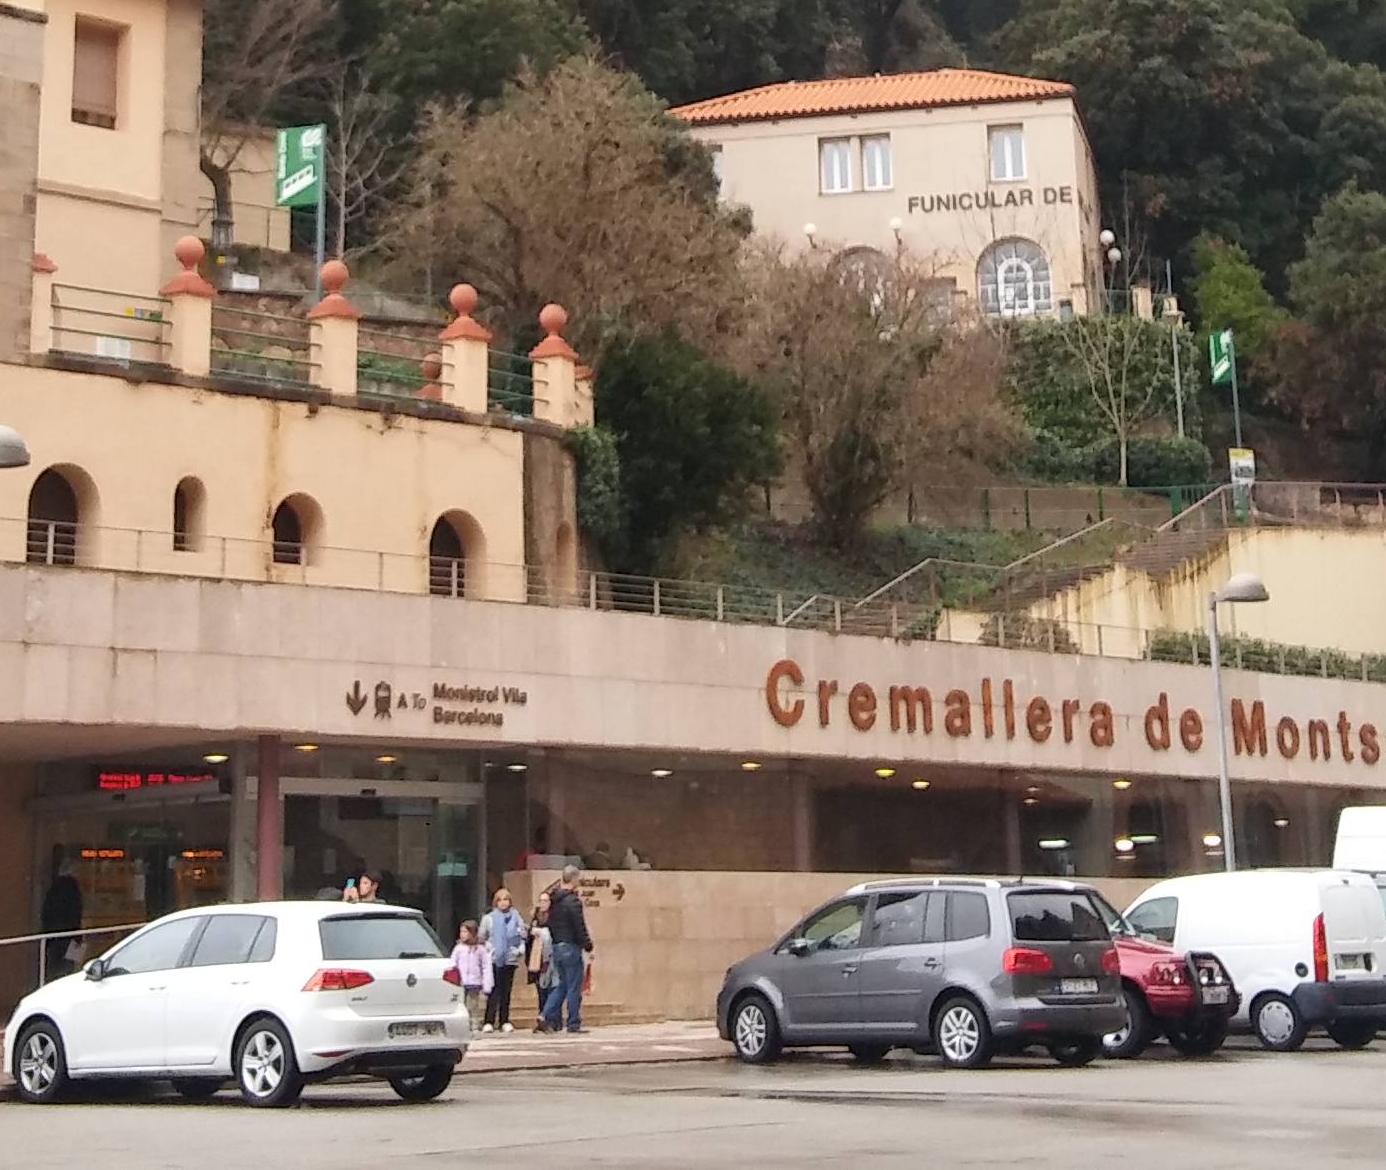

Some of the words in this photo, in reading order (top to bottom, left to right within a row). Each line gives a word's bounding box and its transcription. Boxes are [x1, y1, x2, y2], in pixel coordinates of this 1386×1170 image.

[908, 189, 1033, 213] FUNICULAR
[1043, 186, 1073, 204] DE
[397, 693, 407, 709] A
[412, 693, 427, 709] To
[433, 682, 499, 704] Monistrol
[502, 686, 528, 706] Vila
[766, 658, 1116, 748] Cremallera
[1144, 692, 1204, 753] de
[433, 706, 504, 726] Barcelona
